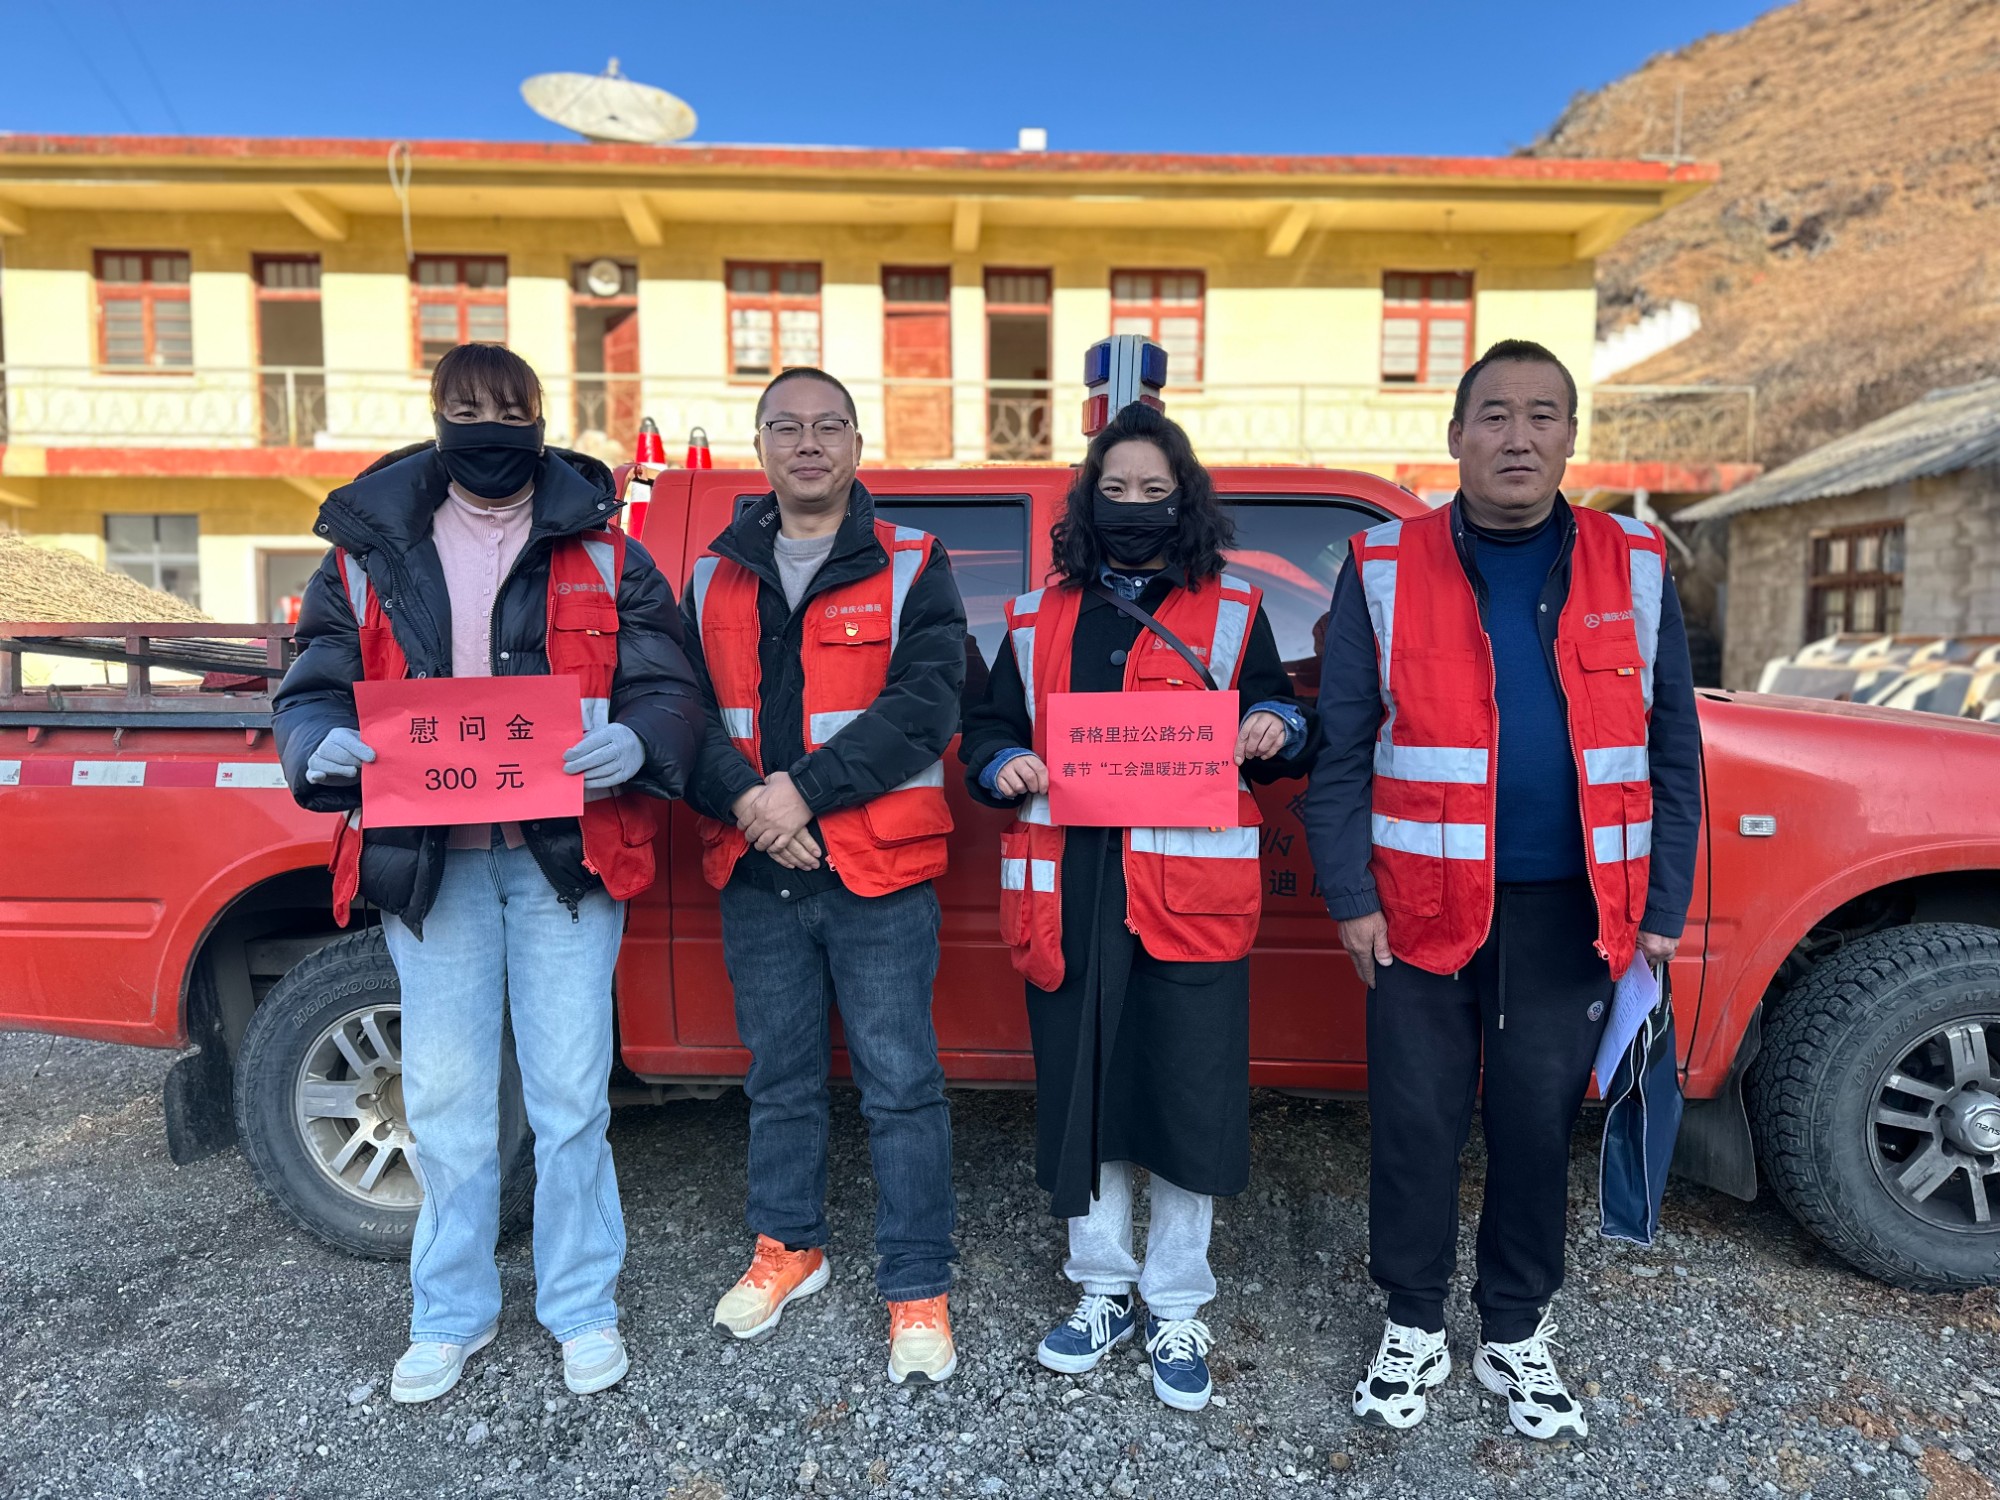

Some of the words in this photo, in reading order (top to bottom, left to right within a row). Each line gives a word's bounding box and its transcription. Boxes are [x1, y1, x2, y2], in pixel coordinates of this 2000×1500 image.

[840, 603, 882, 614] 迪庆公路局
[409, 713, 535, 744] 慰问金
[1068, 725, 1214, 744] 香格里拉公路分局
[425, 767, 477, 791] 300
[495, 763, 525, 791] 元
